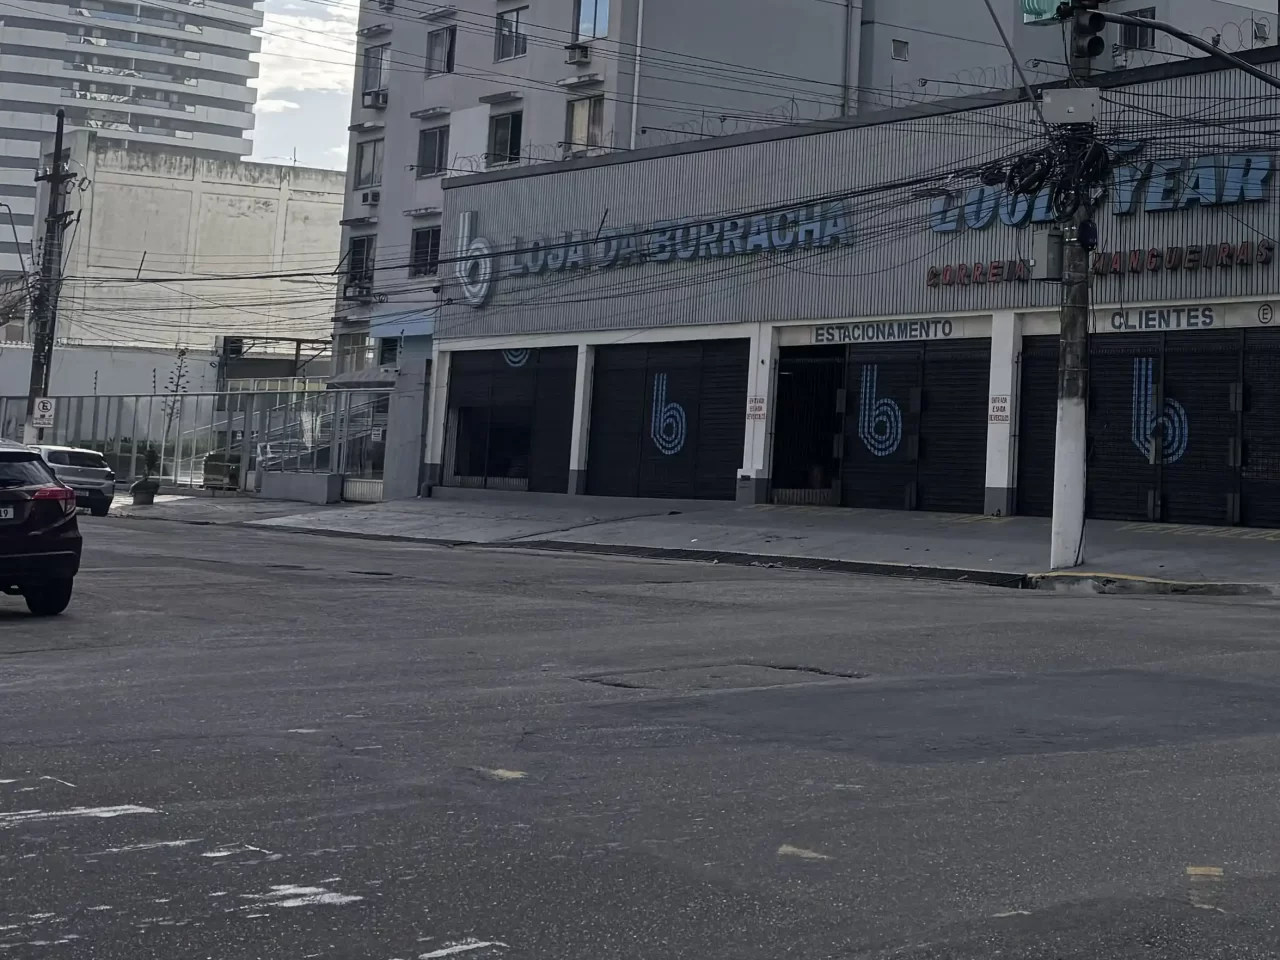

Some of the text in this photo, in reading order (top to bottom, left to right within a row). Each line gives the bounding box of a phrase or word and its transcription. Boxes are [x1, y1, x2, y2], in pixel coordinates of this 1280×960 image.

[1112, 154, 1274, 215] YEAR
[510, 200, 854, 277] LOJA DA BORRACHA
[1092, 239, 1275, 276] MANGUEIRAS
[814, 319, 953, 343] ESTACIONAMENTO
[1111, 307, 1214, 330] CLIENTES
